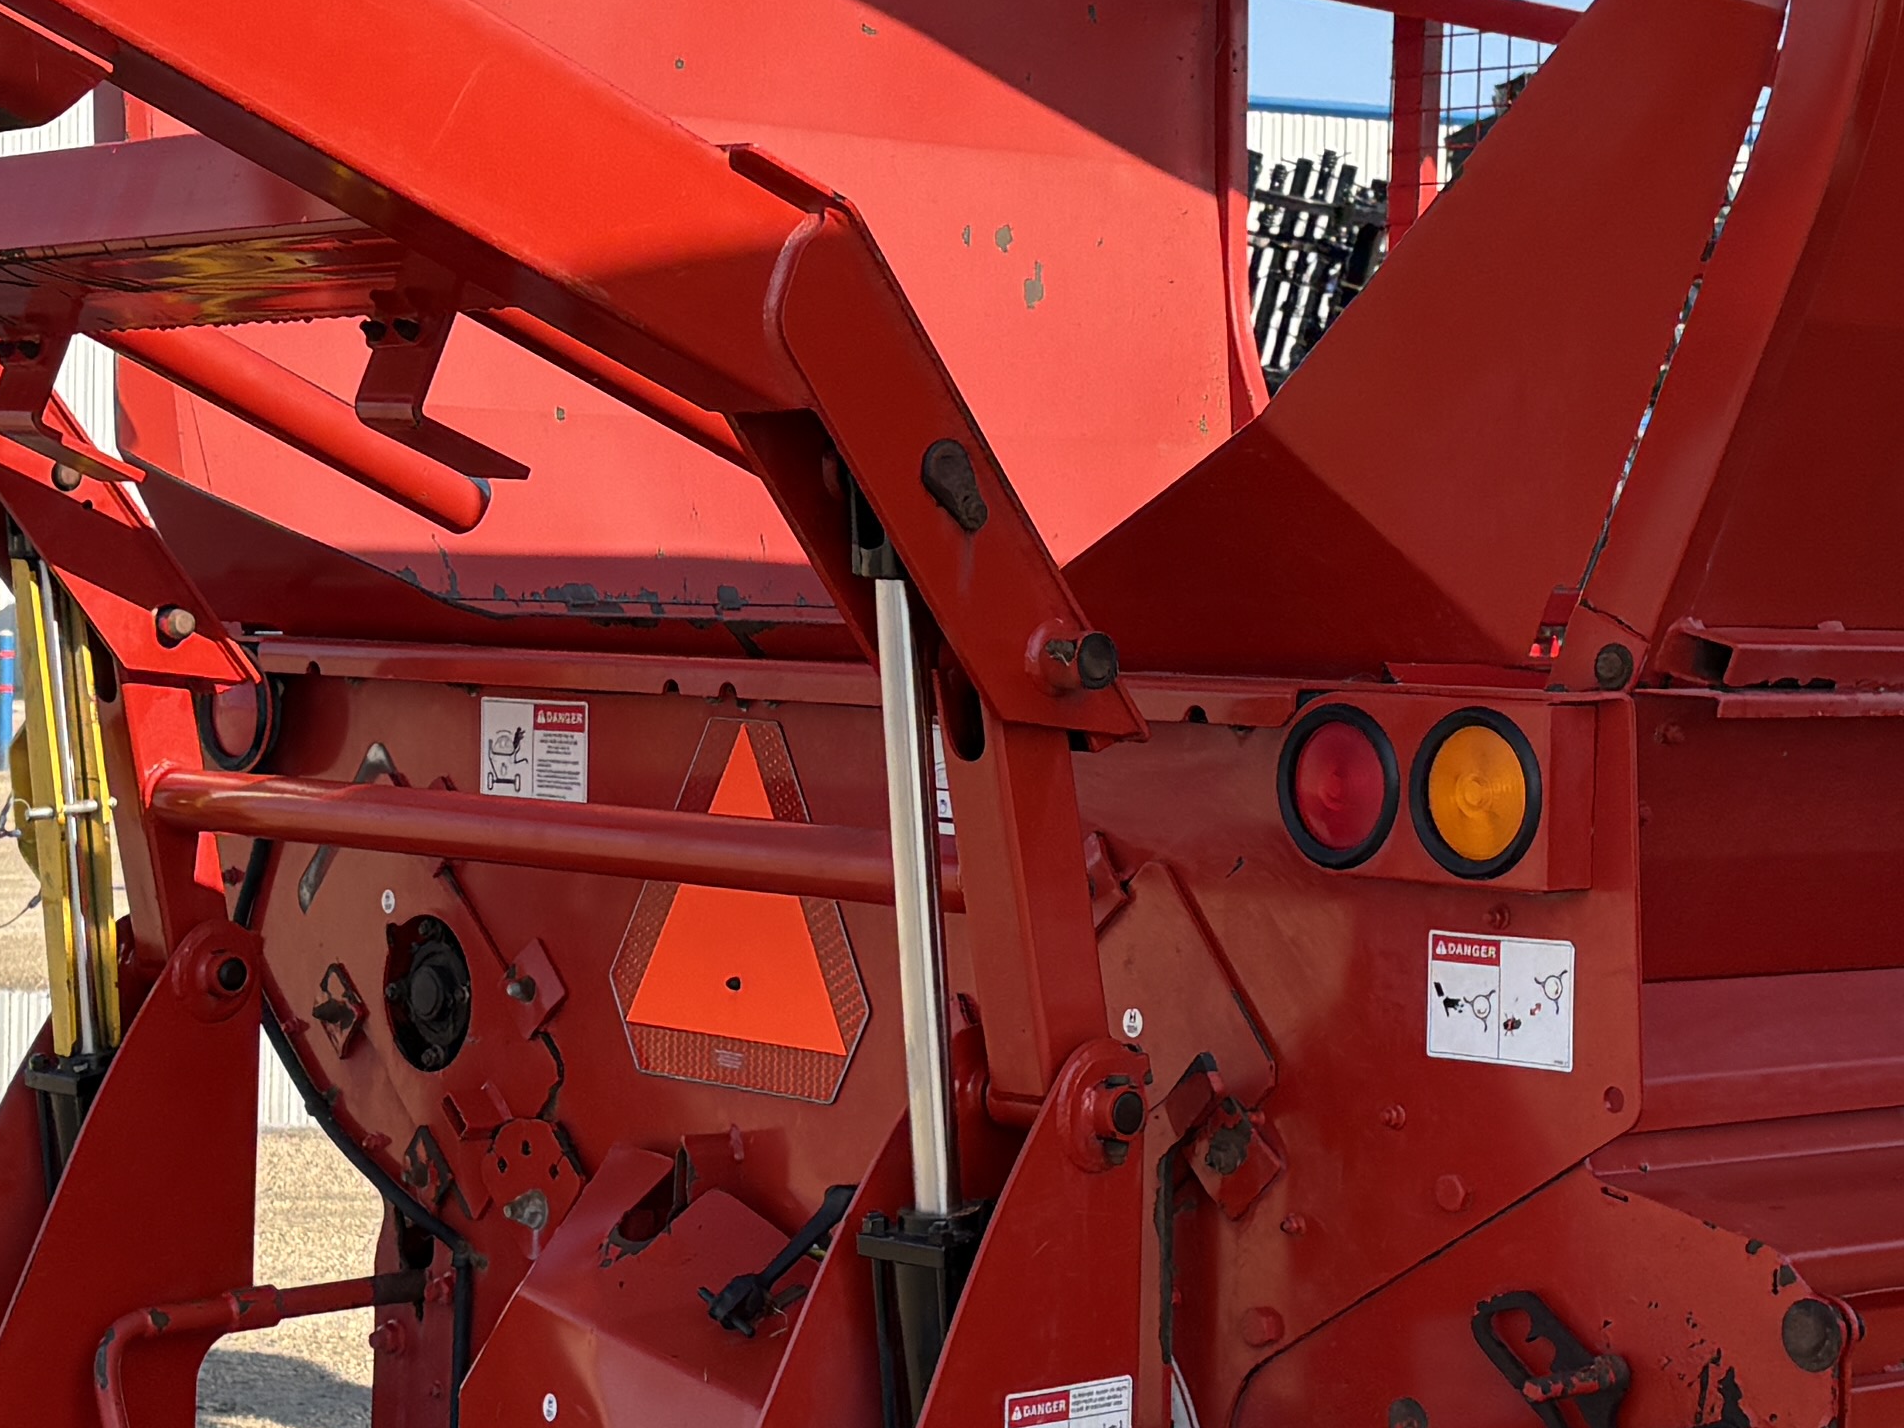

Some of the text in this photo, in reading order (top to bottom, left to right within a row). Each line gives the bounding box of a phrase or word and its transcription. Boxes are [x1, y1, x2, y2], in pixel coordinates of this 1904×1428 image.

[546, 710, 584, 725] DANGER
[1447, 942, 1497, 959] DANGER
[1023, 1399, 1067, 1418] DANGER
